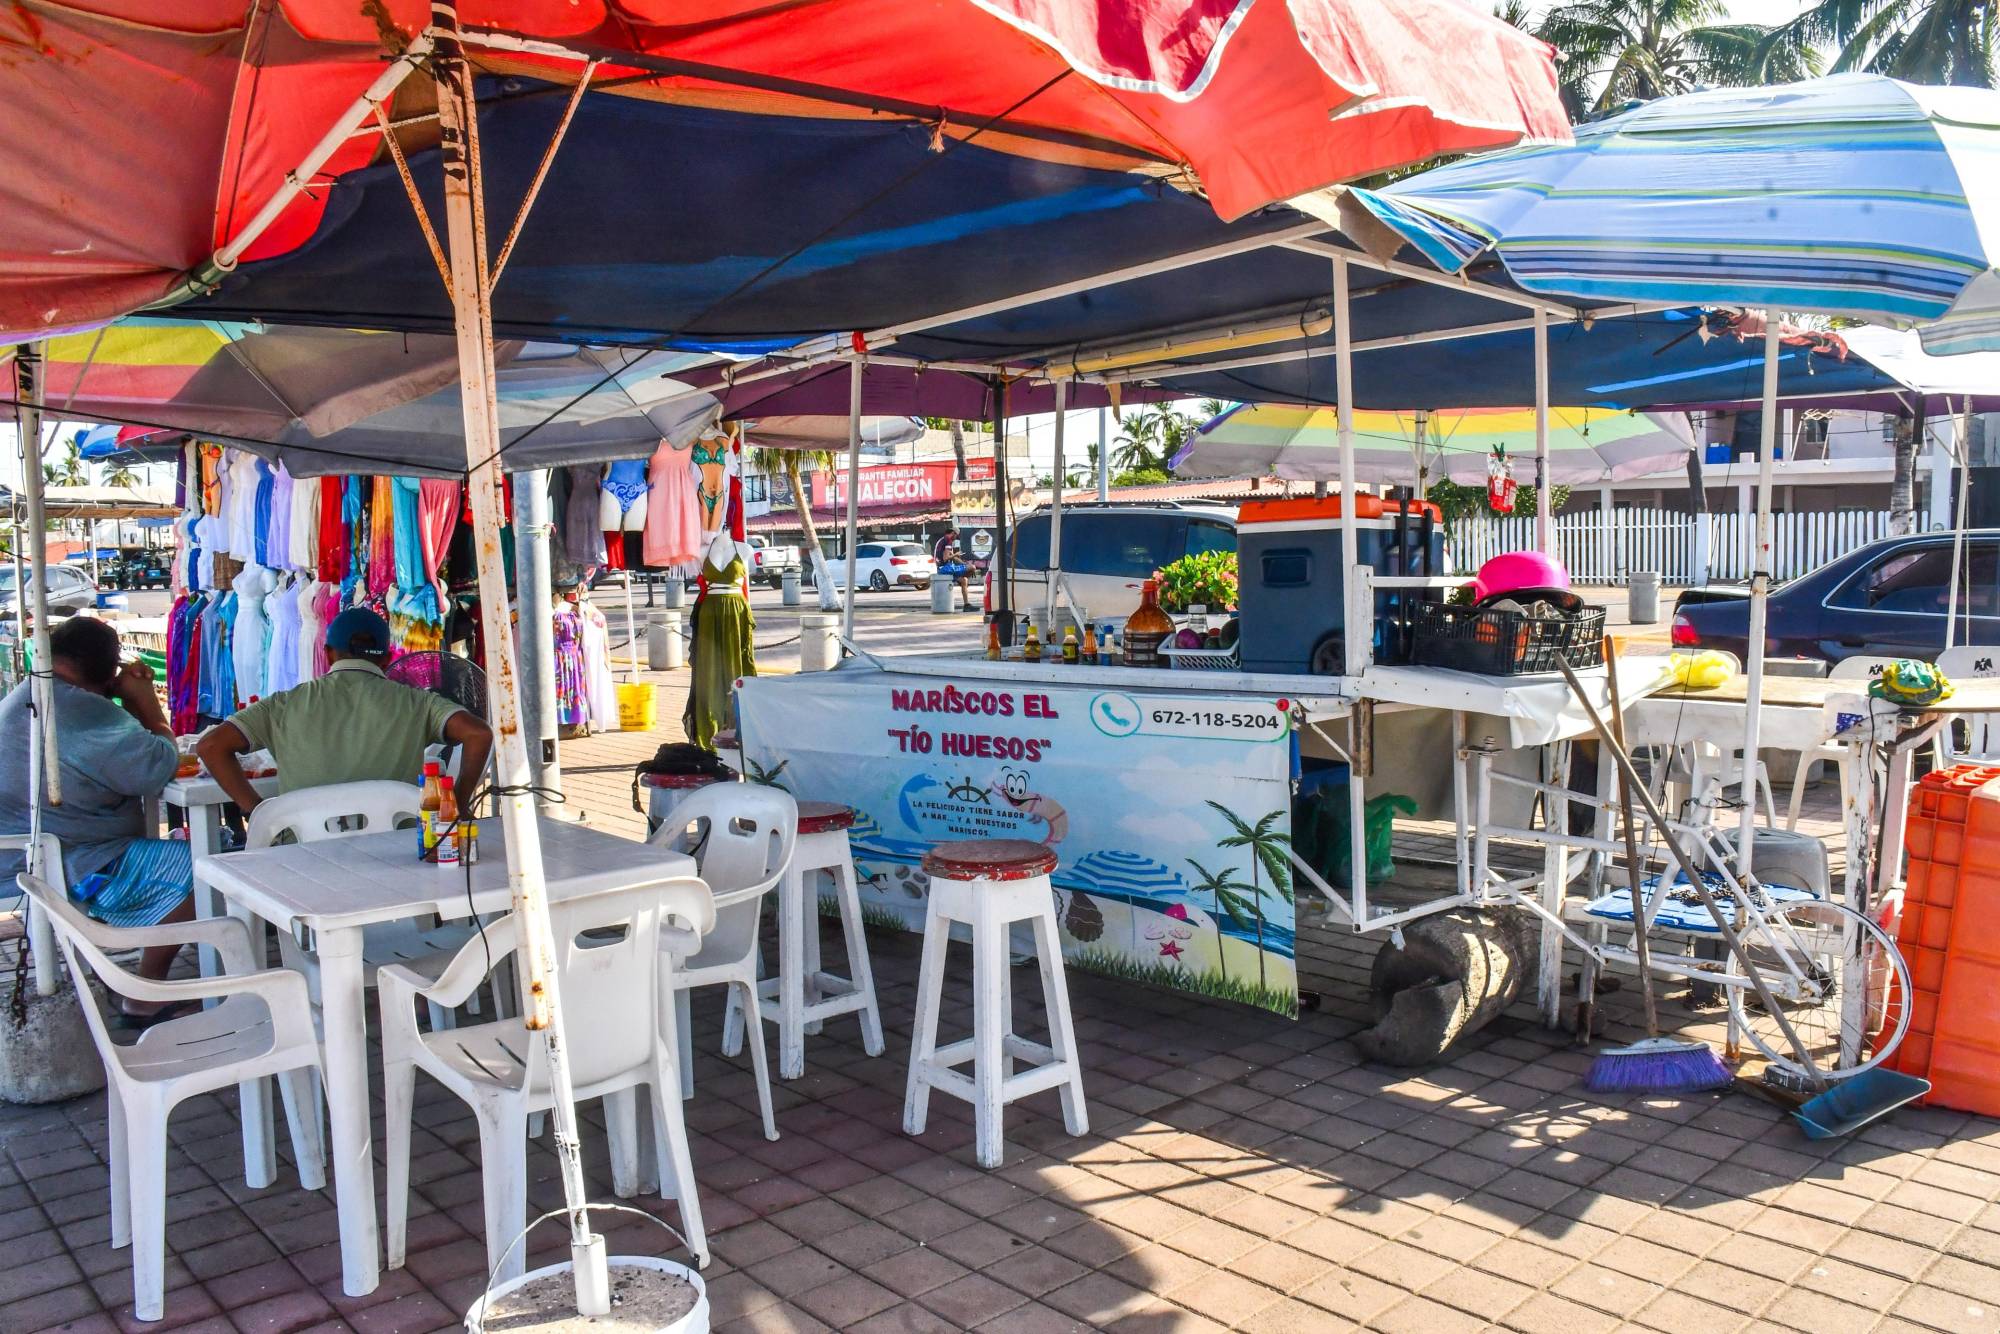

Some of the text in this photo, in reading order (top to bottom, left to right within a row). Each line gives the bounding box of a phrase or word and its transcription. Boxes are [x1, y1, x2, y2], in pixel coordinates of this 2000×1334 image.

[886, 468, 924, 480] FAMILIAR
[825, 478, 932, 503] EL ALECON
[891, 688, 1059, 719] MARISCOS EL
[1152, 710, 1279, 729] 672-118-5204
[887, 724, 1052, 762] "TÍO HUESOS"
[912, 800, 1025, 819] LA FELICIDAD TIENE SABOR
[975, 818, 1017, 830] NUESTROS
